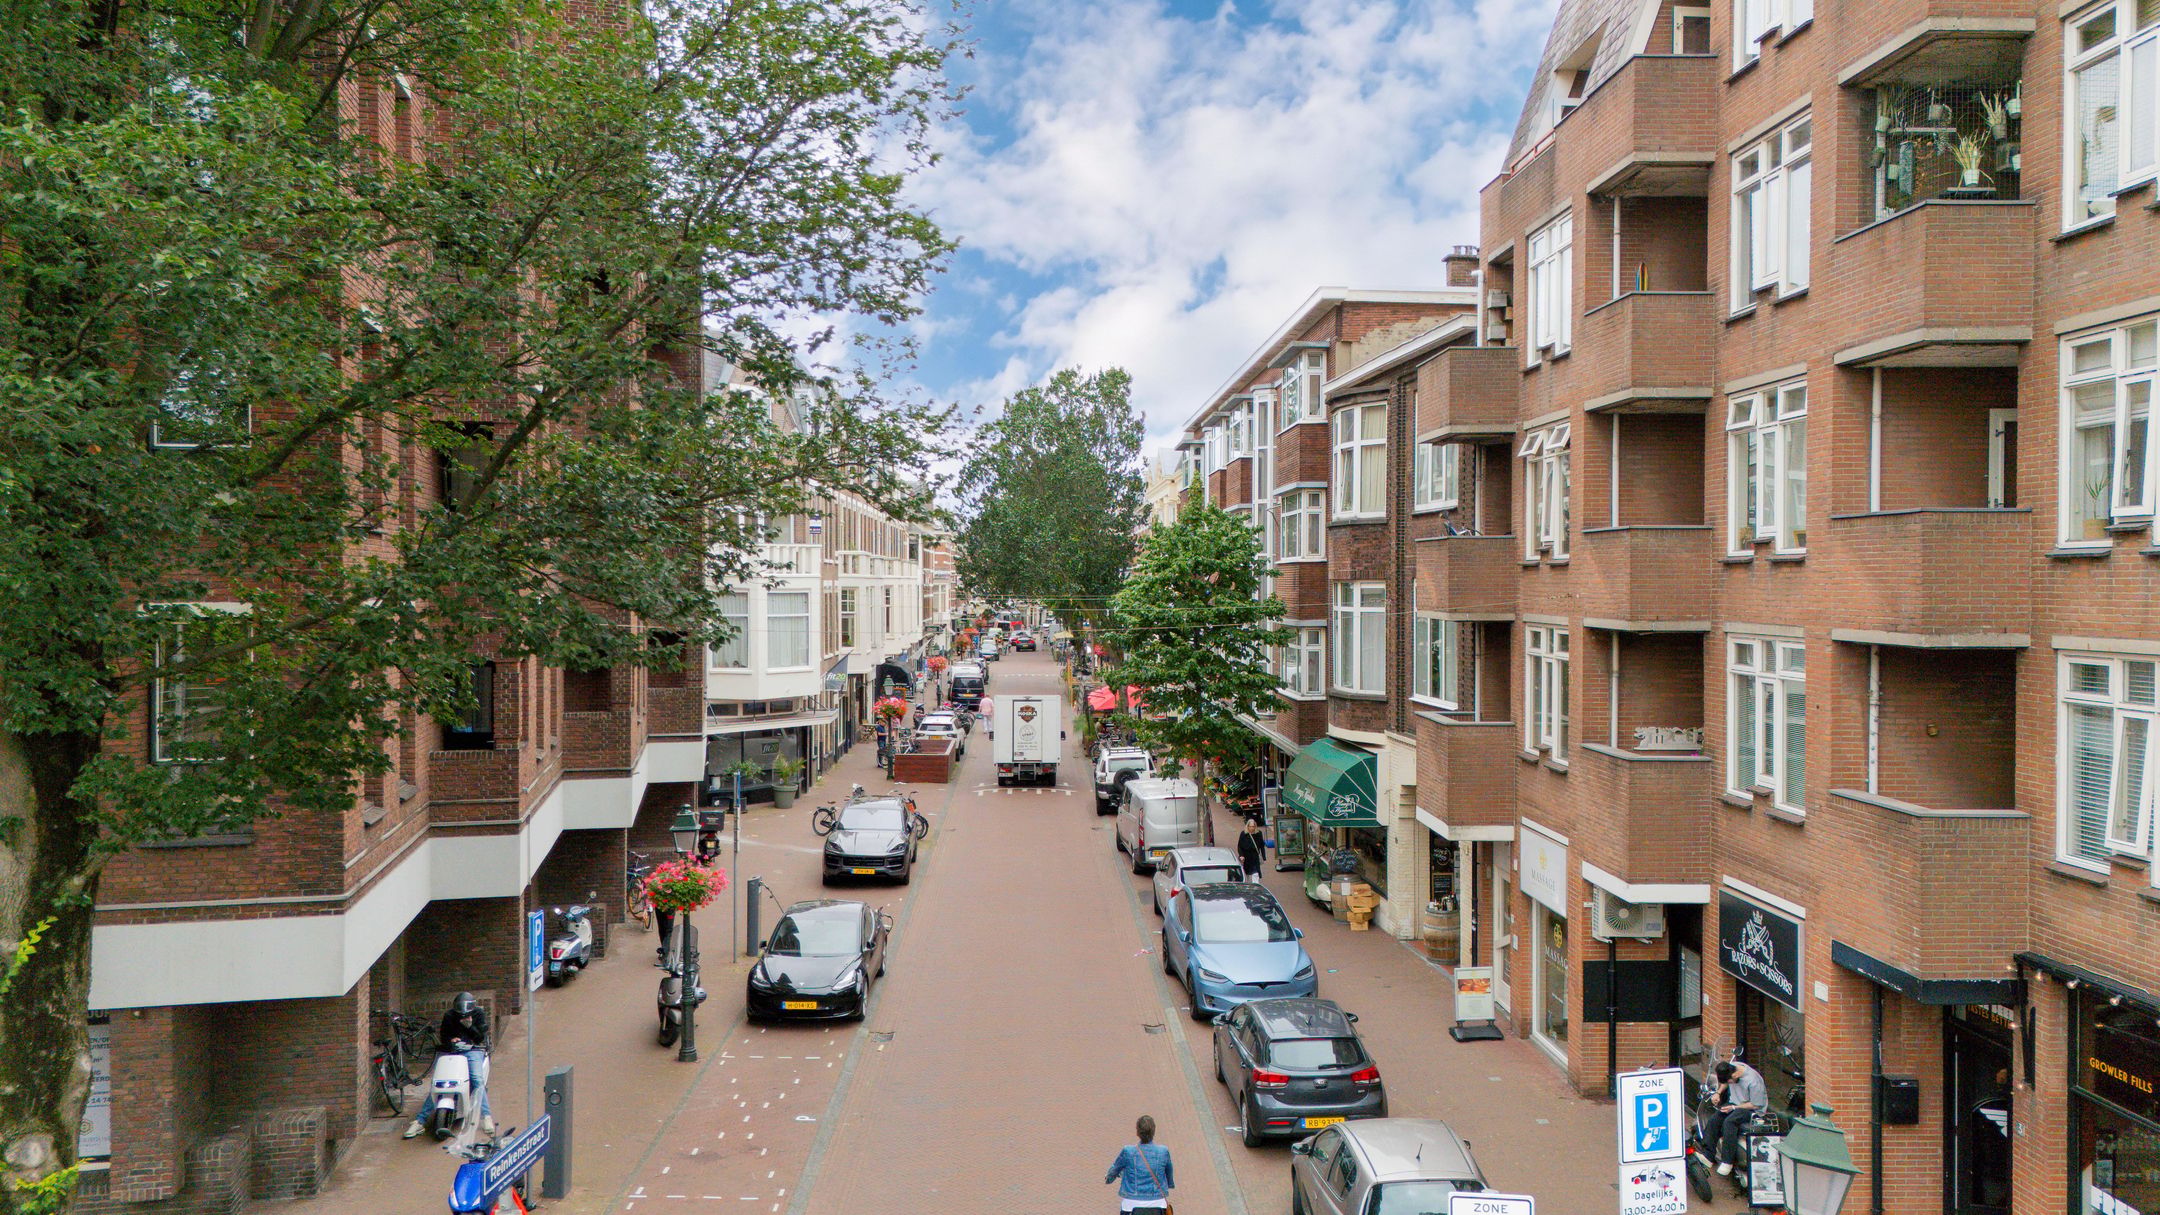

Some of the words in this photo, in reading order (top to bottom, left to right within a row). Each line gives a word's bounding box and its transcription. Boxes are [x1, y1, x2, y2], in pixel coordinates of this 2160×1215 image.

[826, 672, 846, 681] fit20
[1531, 867, 1555, 892] MASSAGE
[535, 918, 542, 947] P
[1760, 961, 1794, 996] SCISSORS
[1639, 1079, 1664, 1089] ZONE
[2089, 1056, 2129, 1083] GROWLER
[2131, 1074, 2154, 1094] FILLS
[1642, 1097, 1663, 1129] P
[489, 1126, 545, 1184] Reinkenstraat
[1474, 1202, 1509, 1215] ZONE
[1634, 1189, 1674, 1202] Dagelijks
